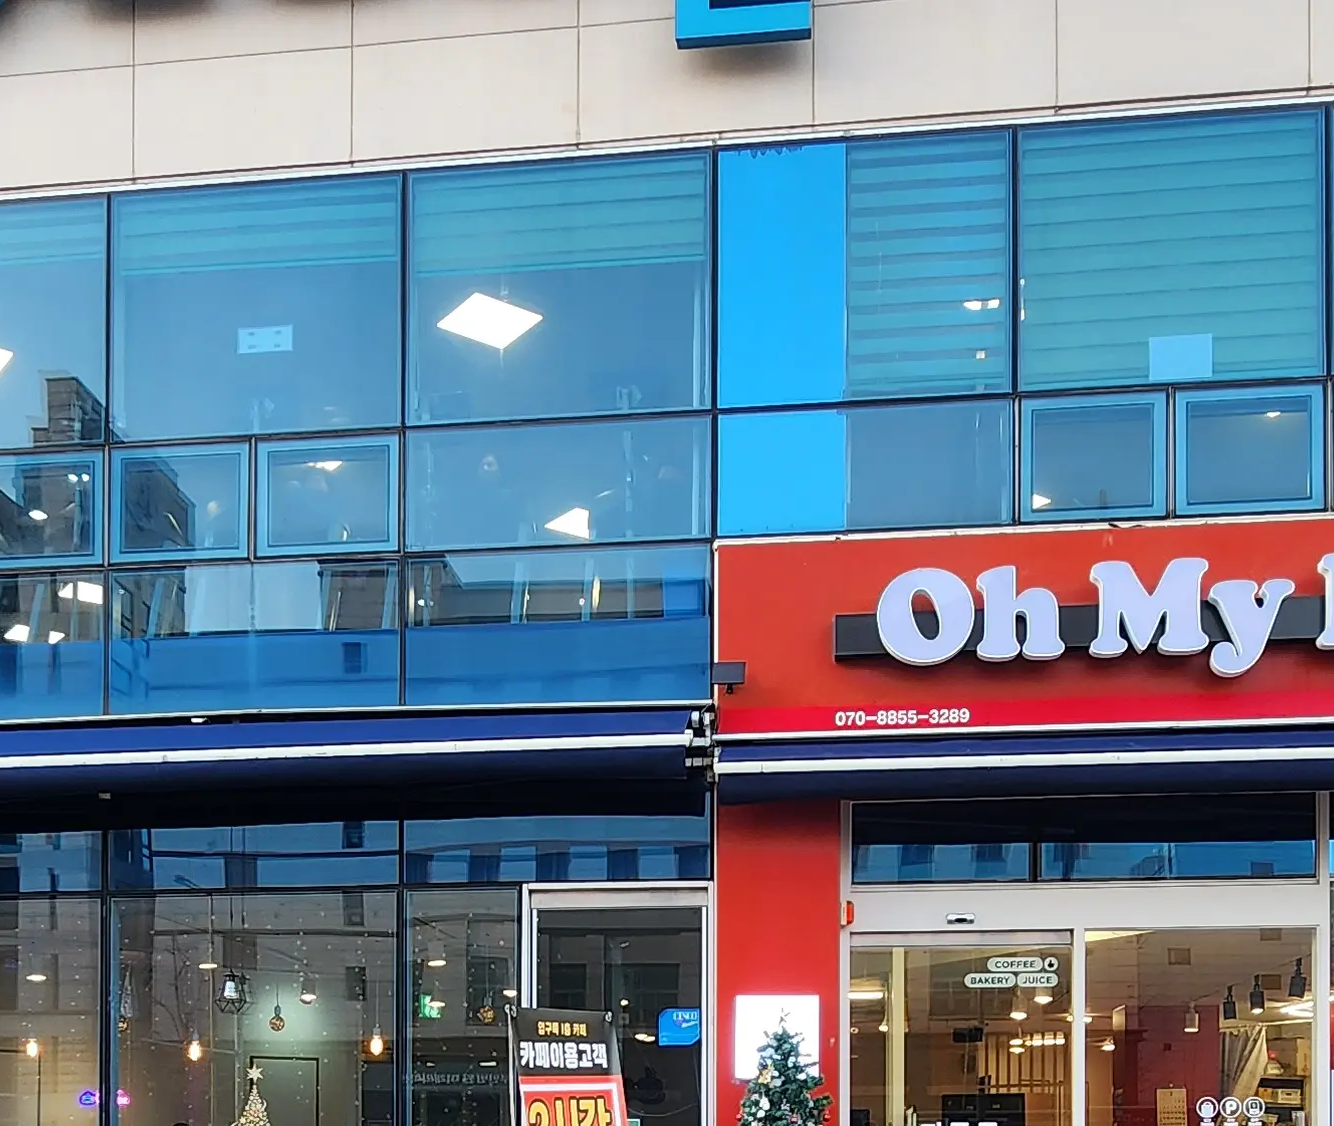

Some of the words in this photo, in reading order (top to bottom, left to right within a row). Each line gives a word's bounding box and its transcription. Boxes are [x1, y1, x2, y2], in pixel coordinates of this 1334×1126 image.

[876, 565, 1065, 666] Oh
[1088, 557, 1296, 678] My
[835, 707, 970, 727] 070-8855-3289
[994, 960, 1036, 969] COFFEE
[970, 976, 1010, 985] BAKERY
[1023, 976, 1053, 984] JUICE
[519, 1041, 608, 1069] 카페이용고객
